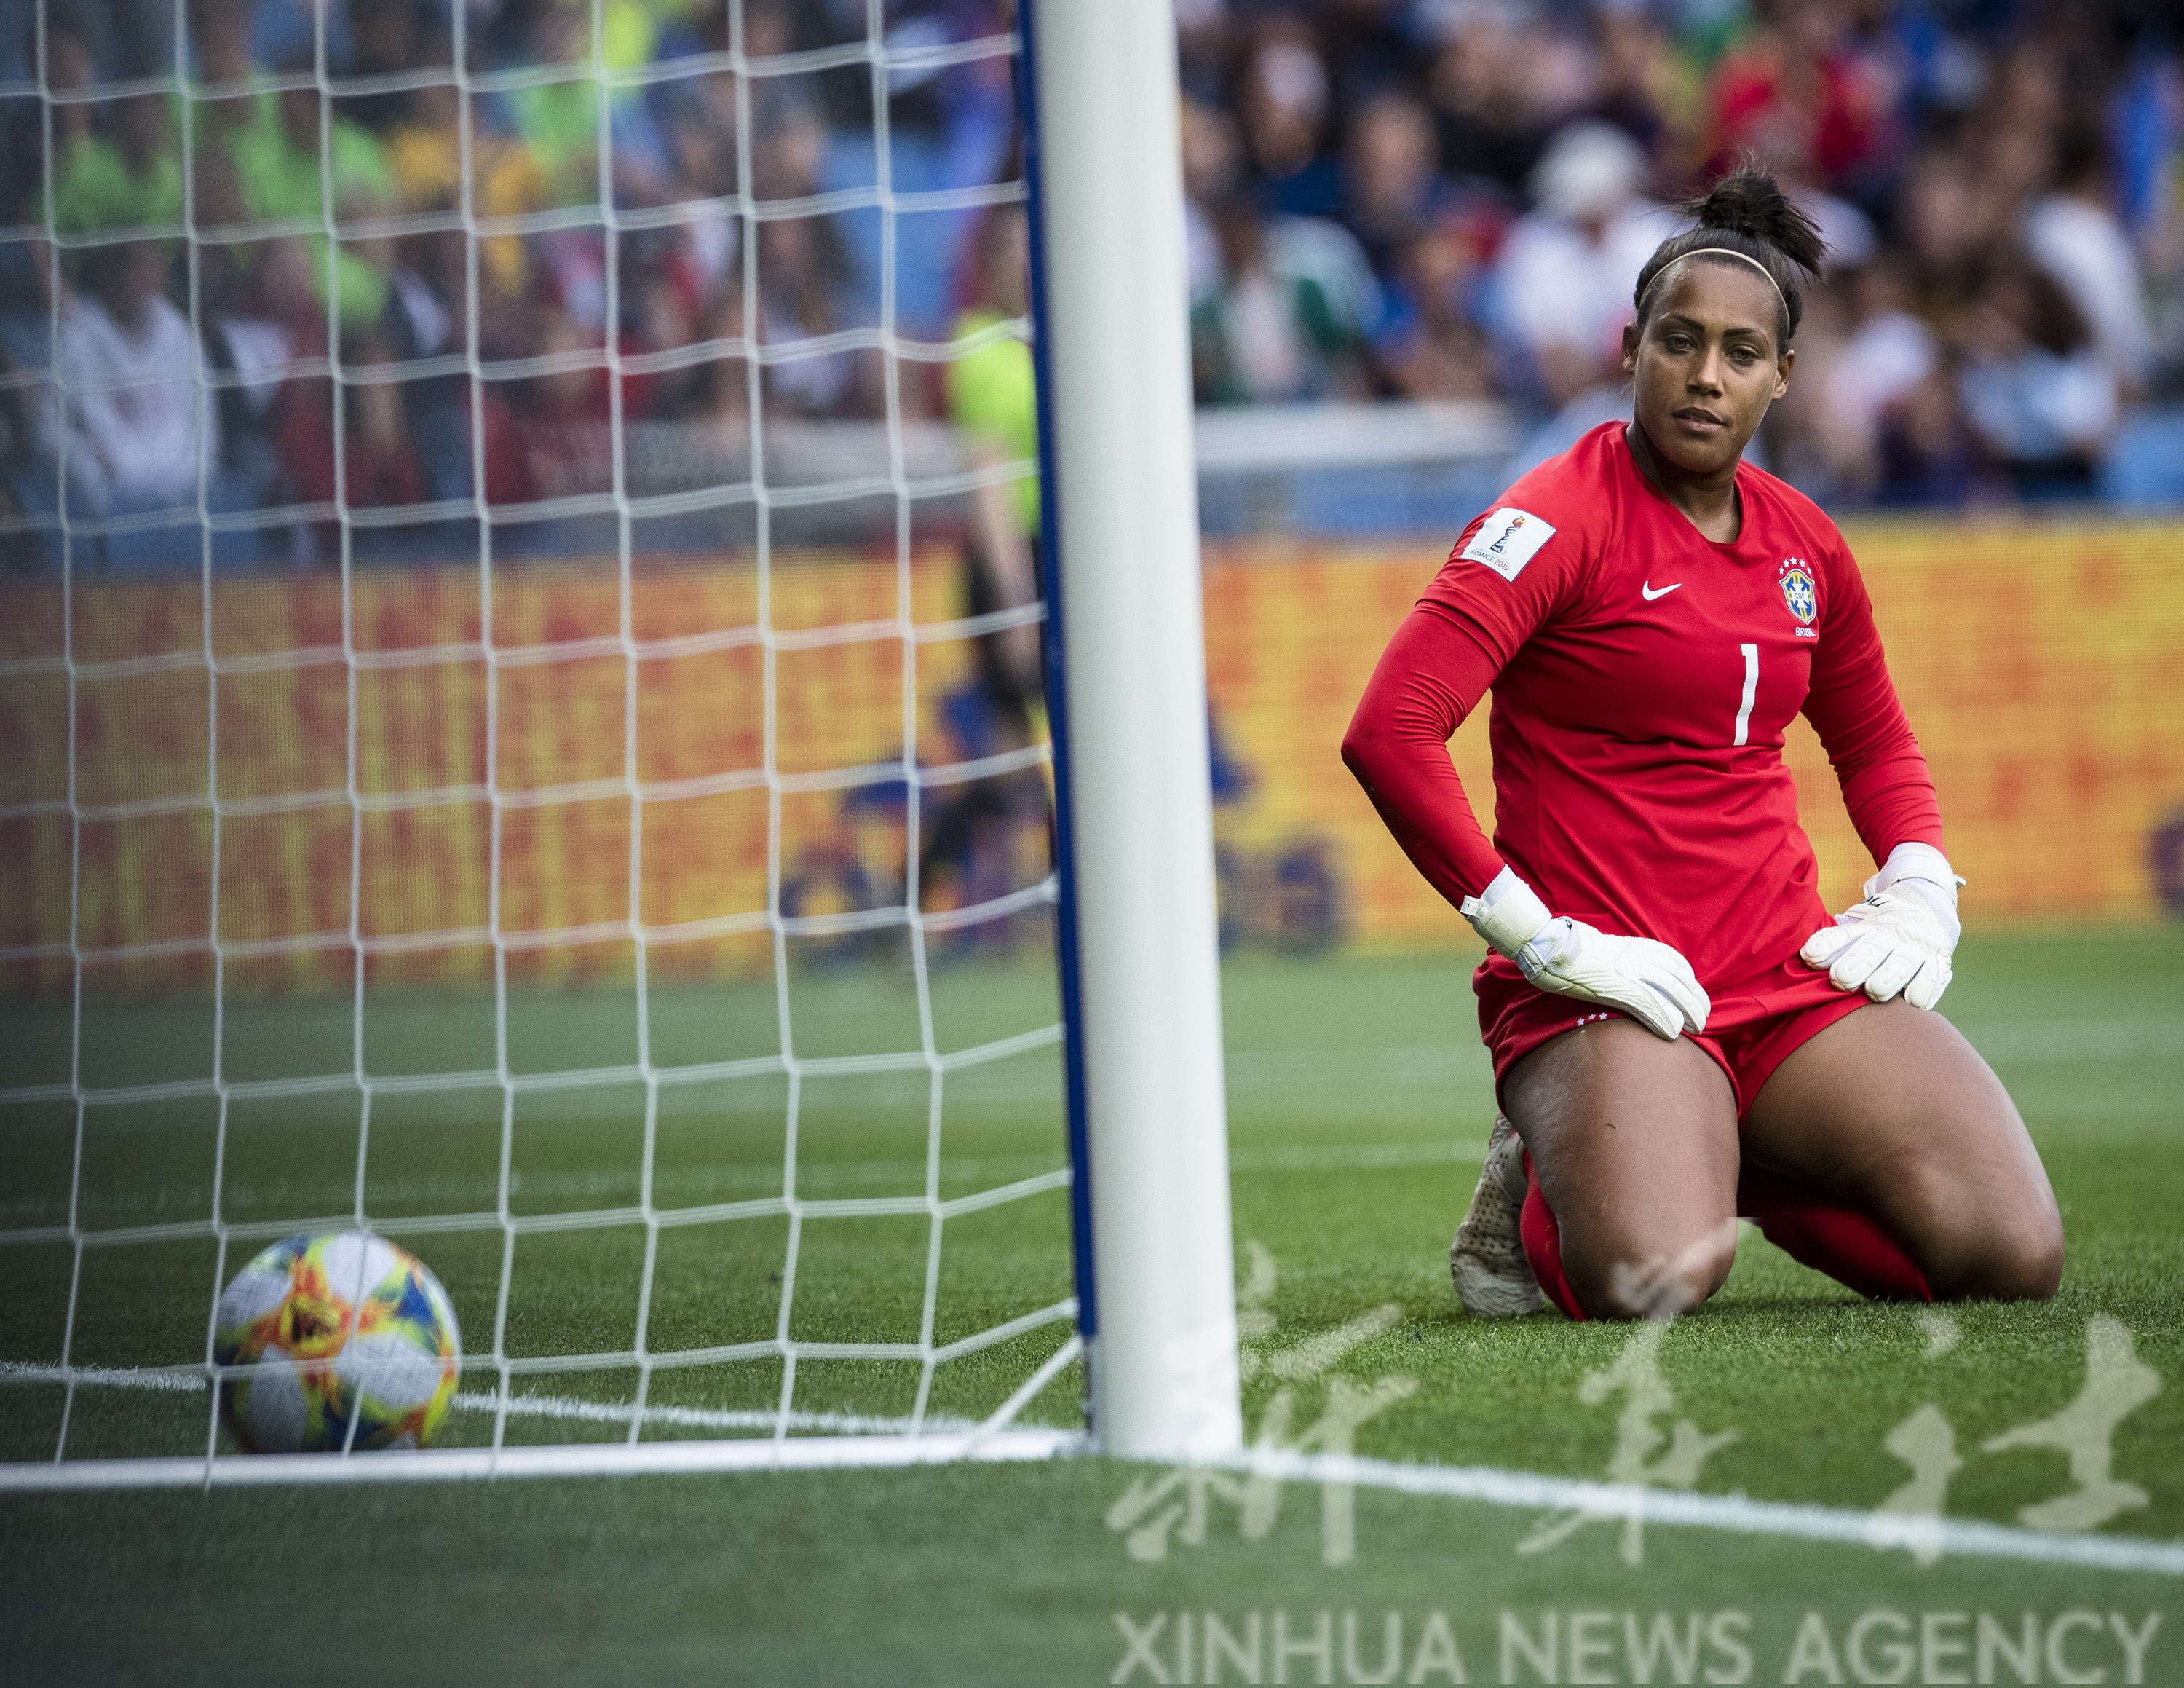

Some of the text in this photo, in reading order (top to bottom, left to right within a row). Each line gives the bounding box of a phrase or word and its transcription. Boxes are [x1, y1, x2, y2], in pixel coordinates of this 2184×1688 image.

[1470, 549, 1495, 562] FRANCE
[1494, 559, 1509, 571] 2019
[1733, 643, 1759, 746] 1
